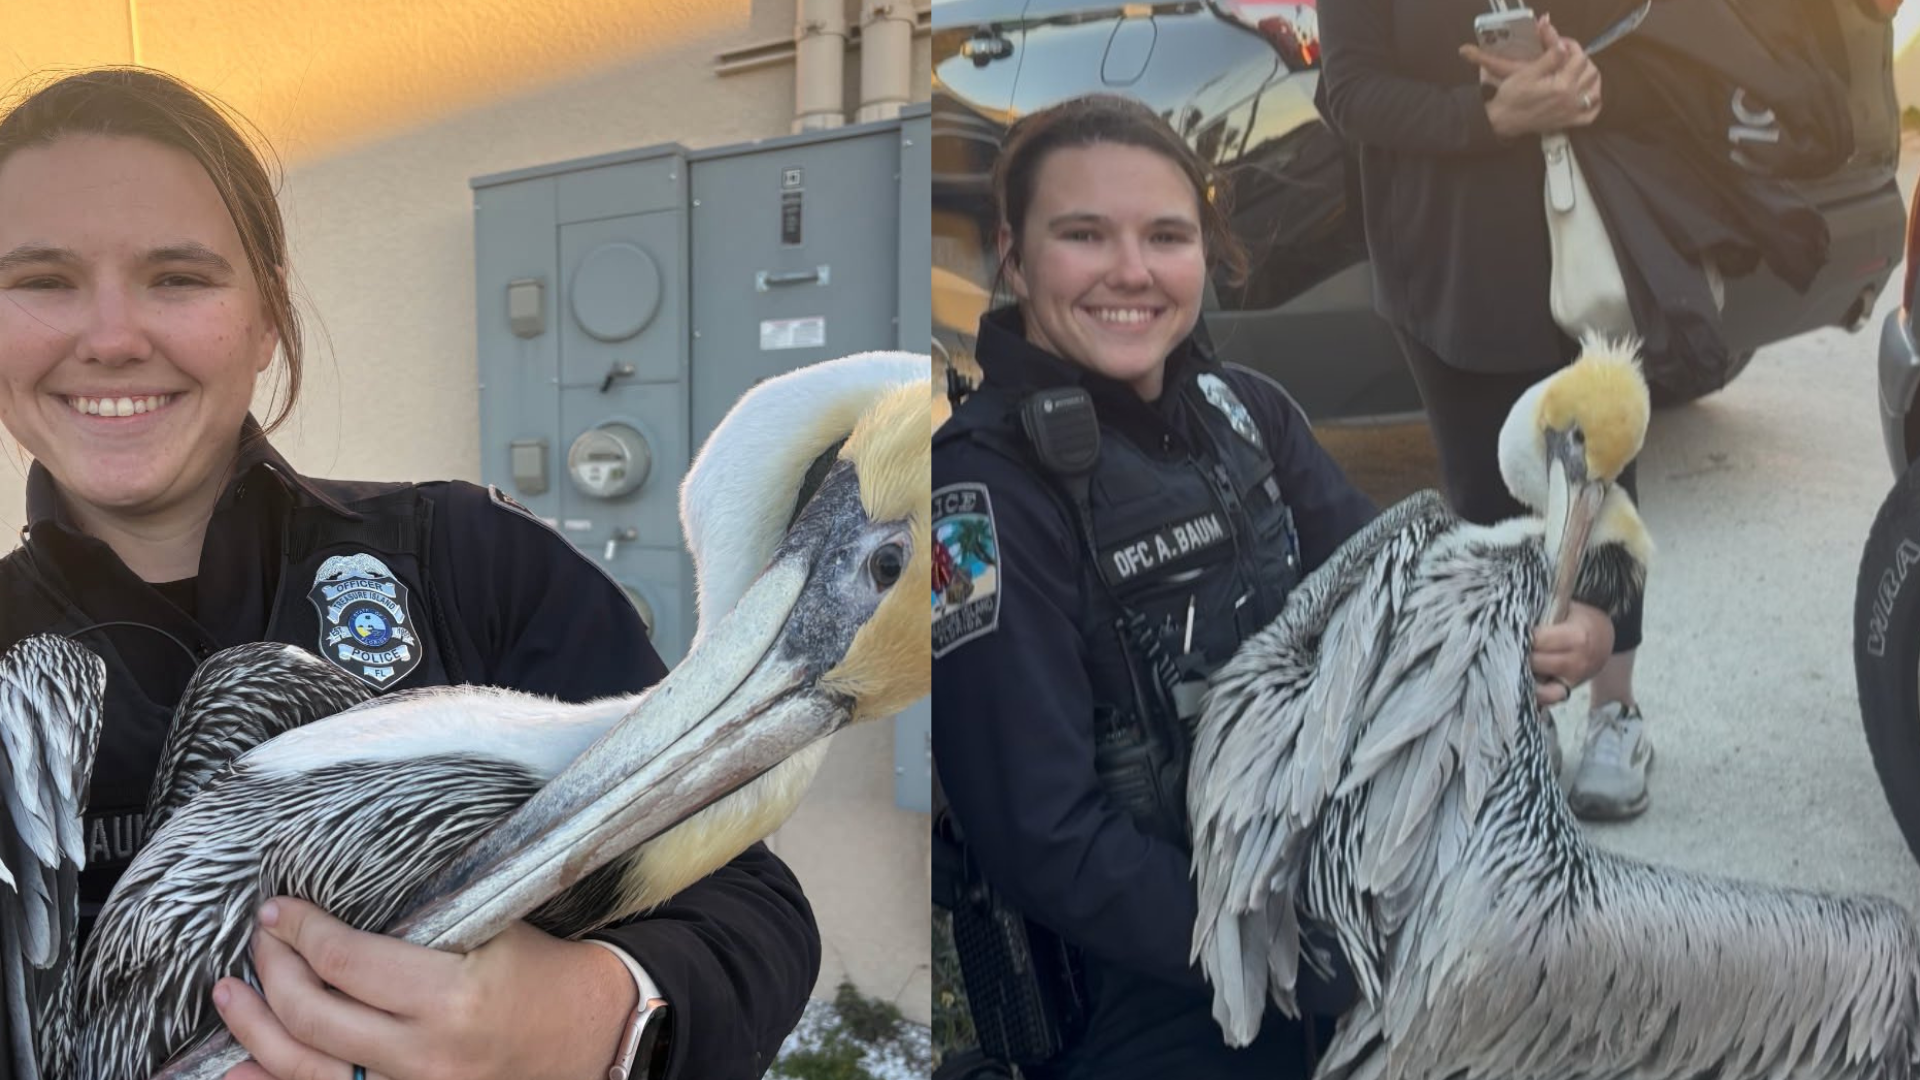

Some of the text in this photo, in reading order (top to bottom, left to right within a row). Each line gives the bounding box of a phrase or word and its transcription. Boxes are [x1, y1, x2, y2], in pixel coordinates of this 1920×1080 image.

[1113, 540, 1154, 578] OFC
[336, 580, 383, 593] OFFICER
[334, 591, 396, 611] TREASURE ISLAND
[352, 648, 401, 664] POLICE
[374, 669, 386, 678] FL
